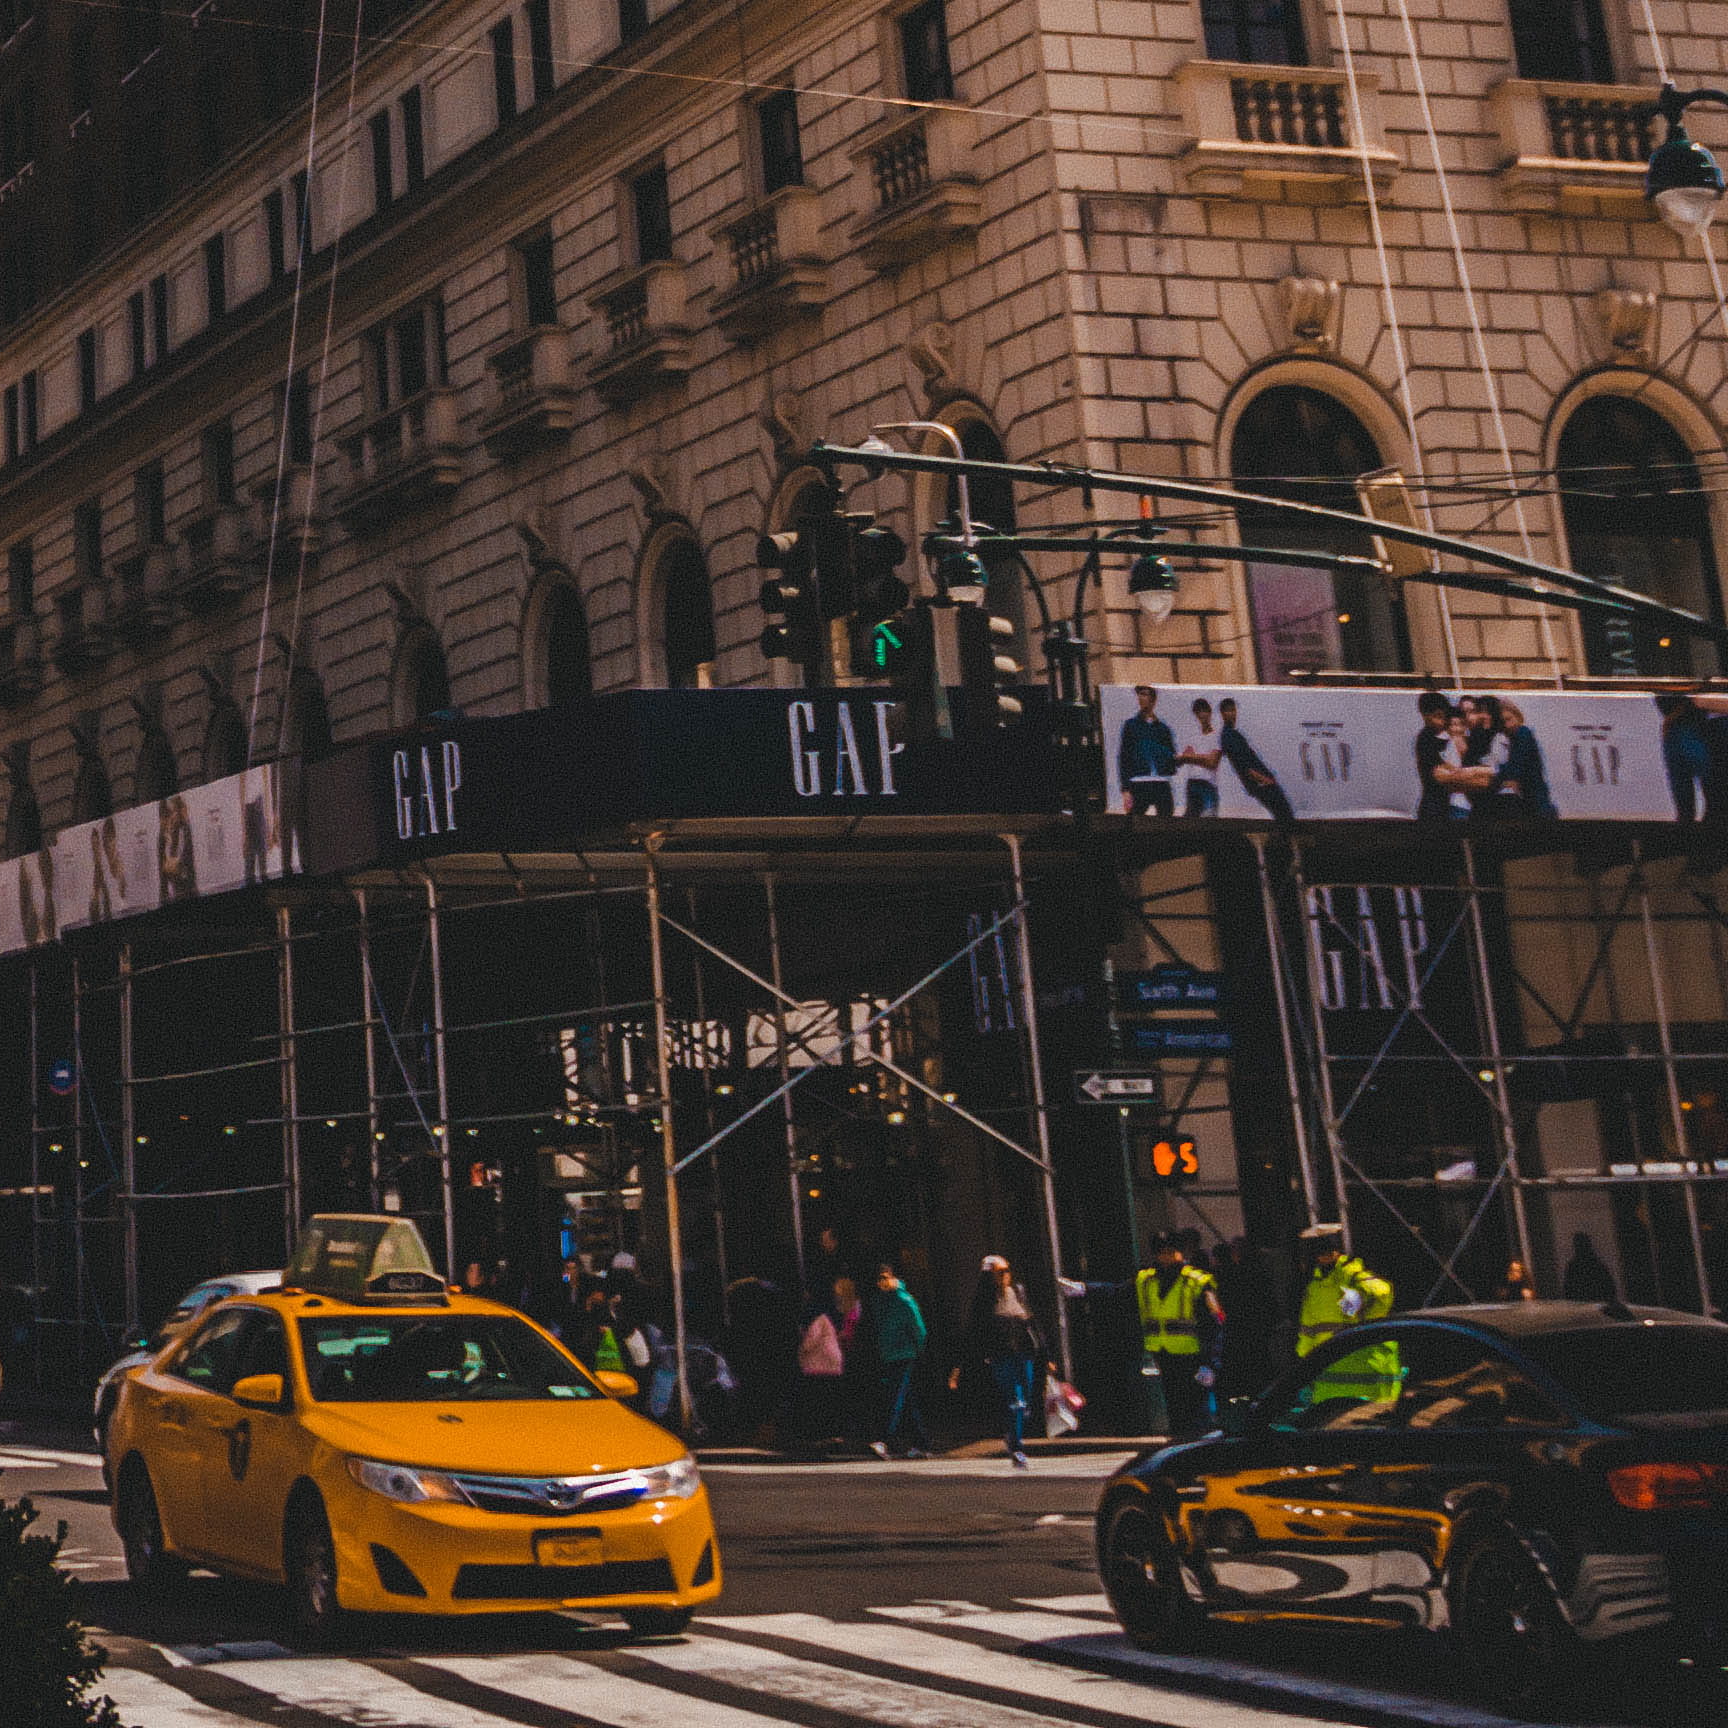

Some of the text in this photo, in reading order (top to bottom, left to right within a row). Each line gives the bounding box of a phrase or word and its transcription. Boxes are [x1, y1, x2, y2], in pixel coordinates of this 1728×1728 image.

[393, 741, 462, 840] GAP
[788, 700, 906, 797] GAP
[1304, 883, 1429, 1010] GAP
[1179, 1142, 1199, 1174] 5
